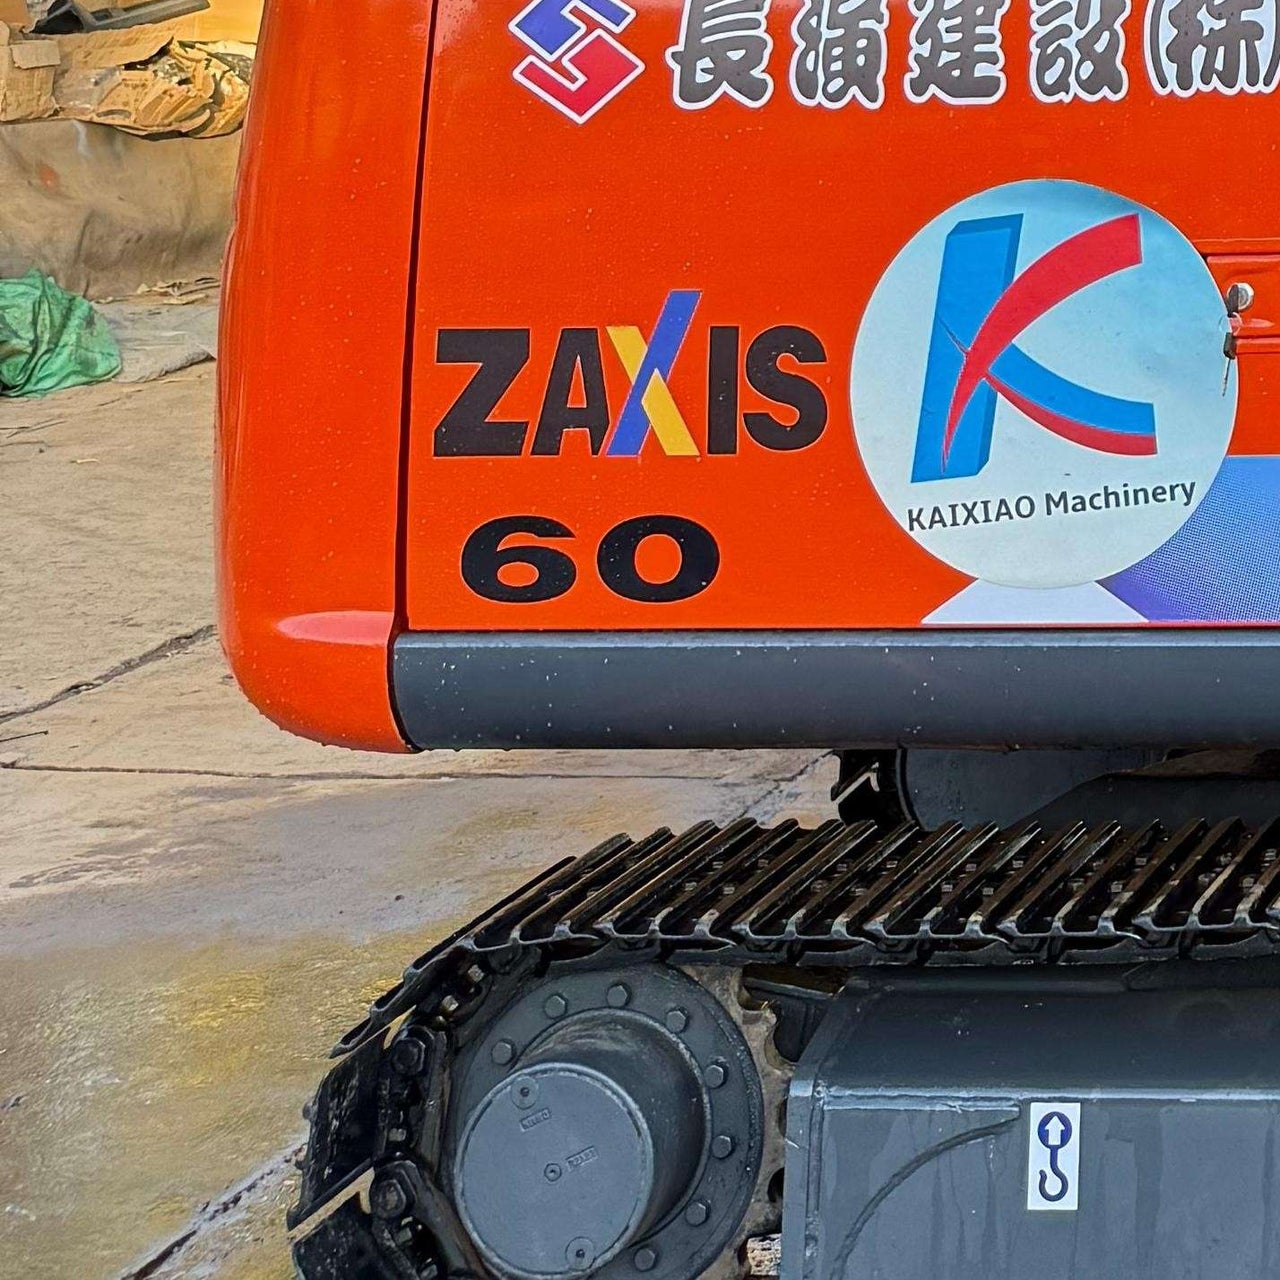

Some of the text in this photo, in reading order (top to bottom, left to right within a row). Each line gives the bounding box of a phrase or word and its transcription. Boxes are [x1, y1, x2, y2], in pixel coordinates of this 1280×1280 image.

[432, 288, 829, 459] ZAXIS
[907, 481, 1197, 532] KAIXIAO Machinery
[459, 513, 721, 605] 60
